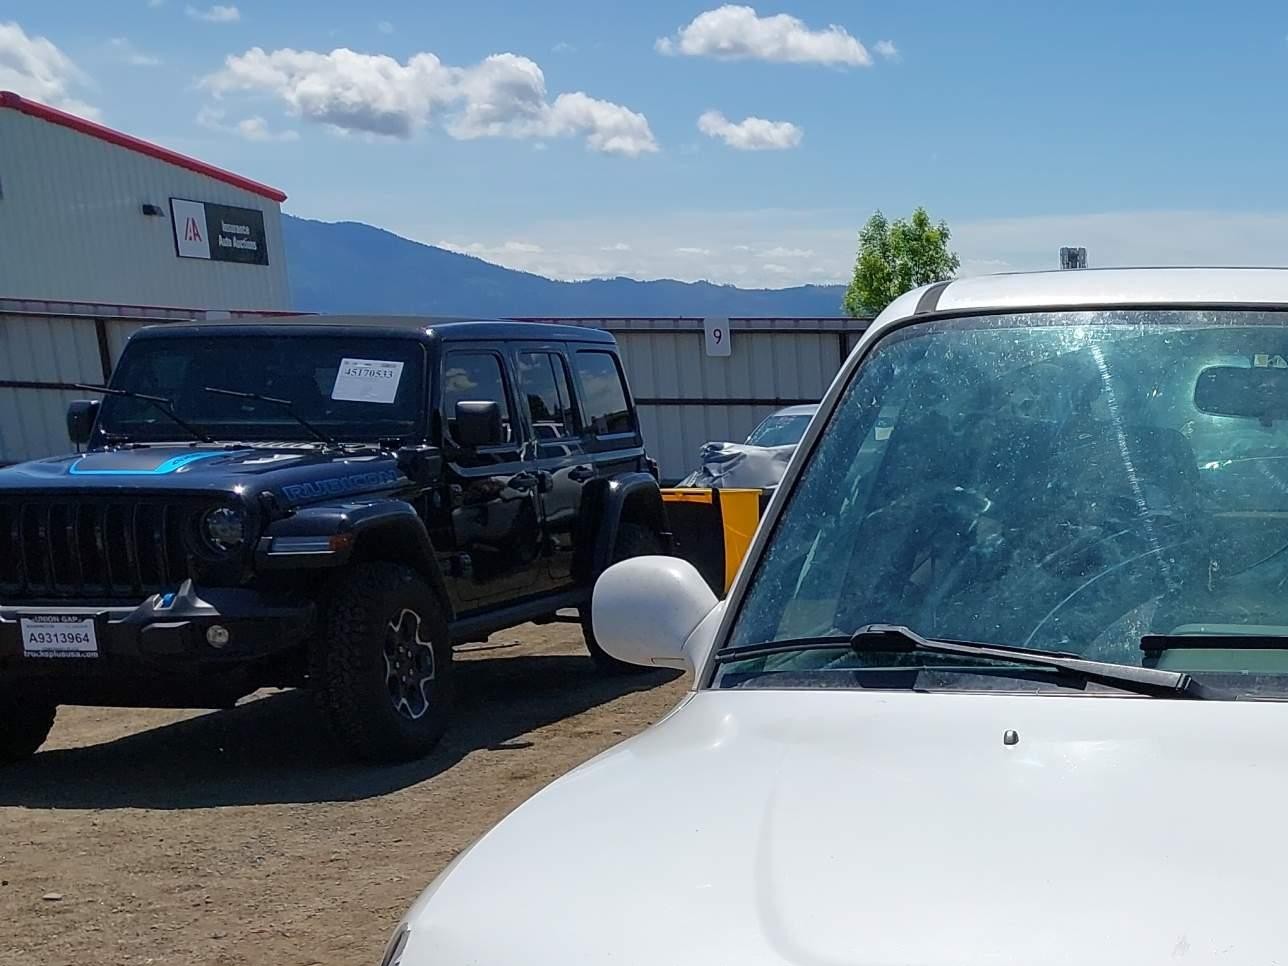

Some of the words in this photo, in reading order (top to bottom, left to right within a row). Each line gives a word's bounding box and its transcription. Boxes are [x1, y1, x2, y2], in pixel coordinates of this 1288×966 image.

[222, 219, 250, 234] Insurance
[219, 234, 232, 247] Auto
[233, 236, 257, 250] Auctions
[713, 328, 722, 344] 9
[284, 470, 397, 501] RUBICON
[34, 615, 60, 623] UNION
[61, 615, 78, 623] GAP
[29, 632, 90, 644] A9313964
